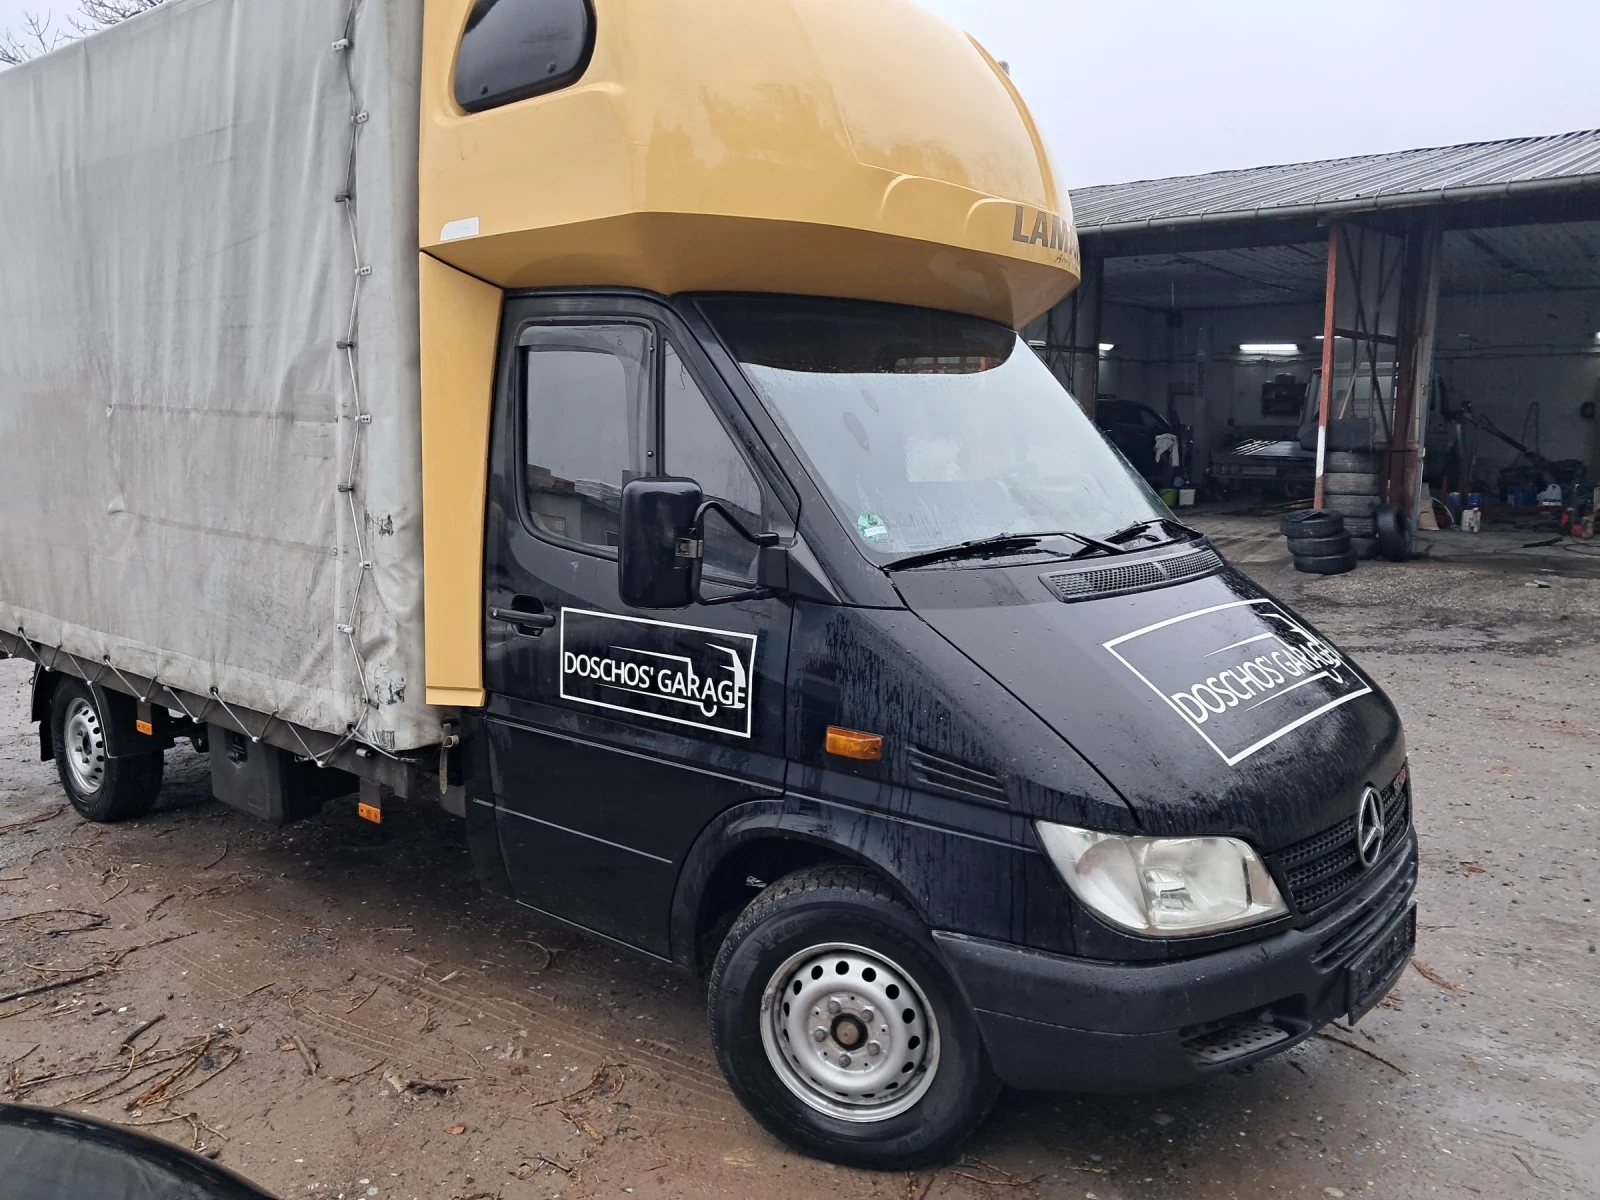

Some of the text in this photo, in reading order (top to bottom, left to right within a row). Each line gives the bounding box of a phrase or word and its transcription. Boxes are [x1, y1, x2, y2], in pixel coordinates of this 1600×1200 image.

[564, 651, 746, 709] DOSCHOS' GARAGE
[1171, 641, 1342, 724] DOSCHOS' GARAGE
